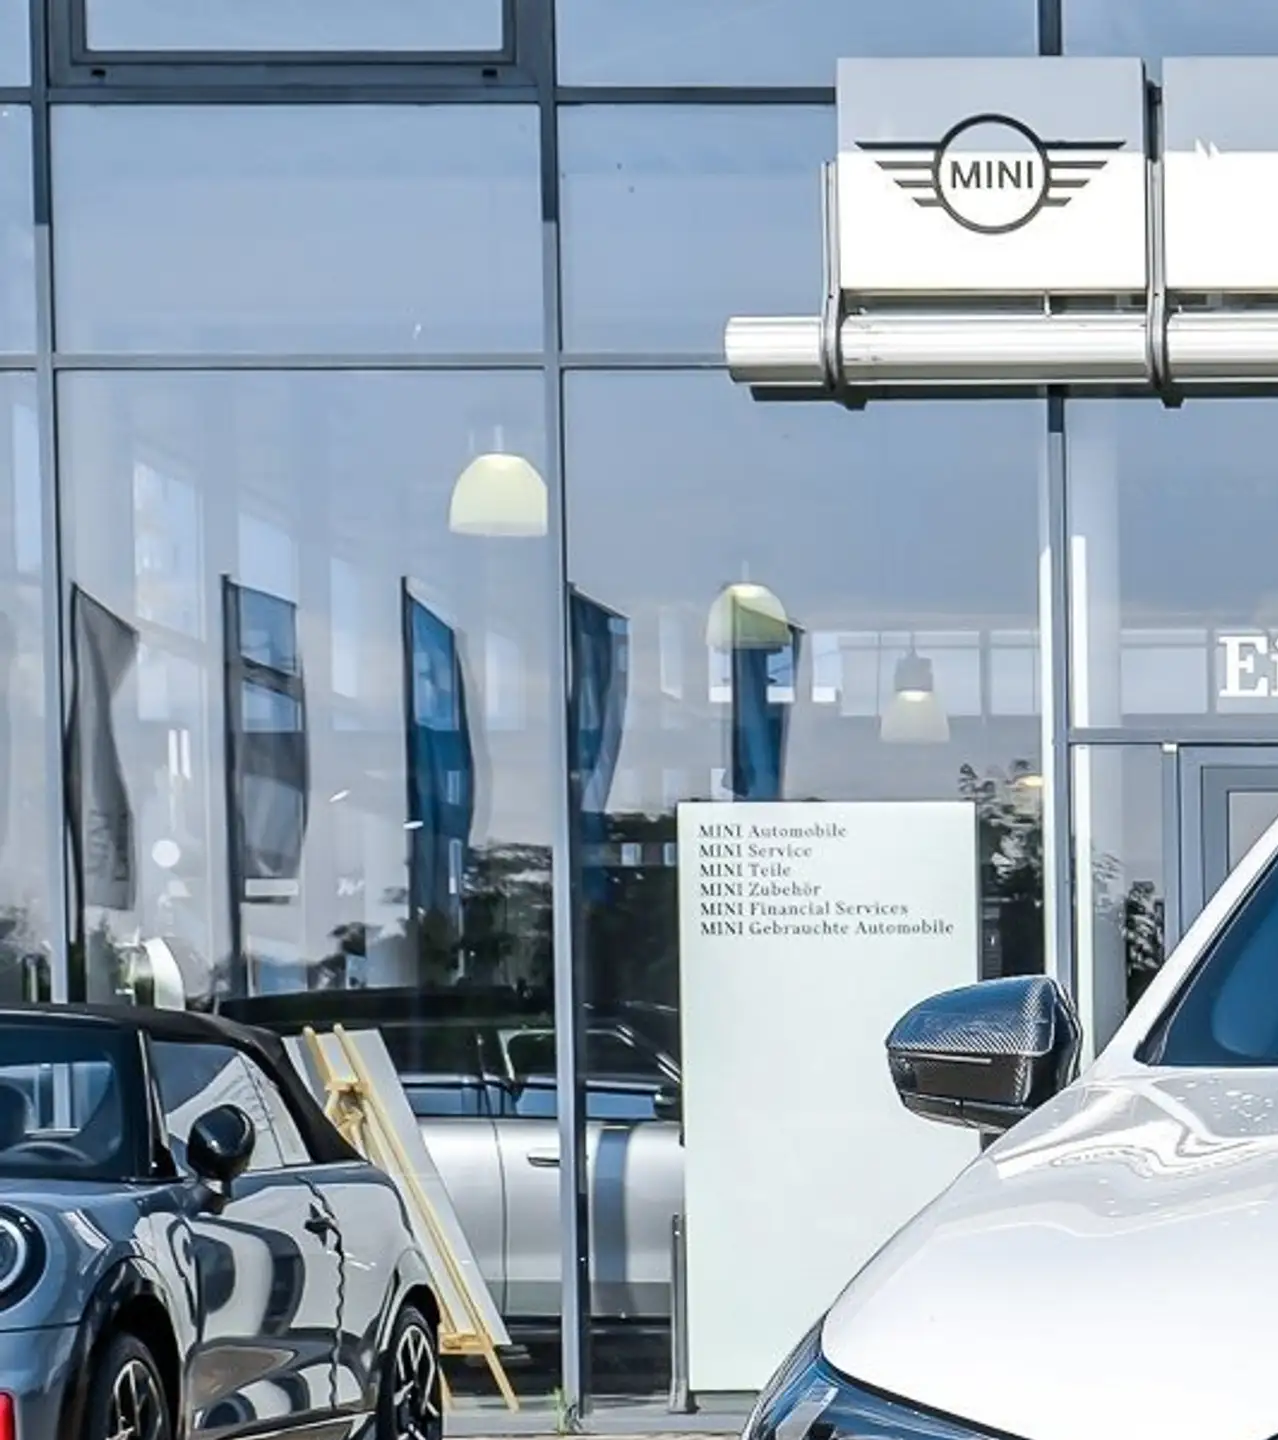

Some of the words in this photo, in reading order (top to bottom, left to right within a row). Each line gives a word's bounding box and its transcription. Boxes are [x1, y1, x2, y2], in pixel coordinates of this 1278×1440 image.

[951, 160, 1034, 190] MINI
[699, 824, 741, 838] MINI
[749, 822, 847, 838] Automobile
[699, 843, 742, 858] MINI
[748, 842, 812, 858] Service
[699, 862, 743, 877] MINI
[748, 862, 792, 877] Teile
[700, 882, 743, 897] MINI
[748, 881, 821, 897] Zubehör
[700, 901, 743, 917] MINI
[750, 901, 830, 917] Financial
[835, 901, 909, 917] Services
[700, 920, 744, 936] MINI
[748, 919, 849, 936] Gebrauchte
[855, 919, 954, 936] Automobile
